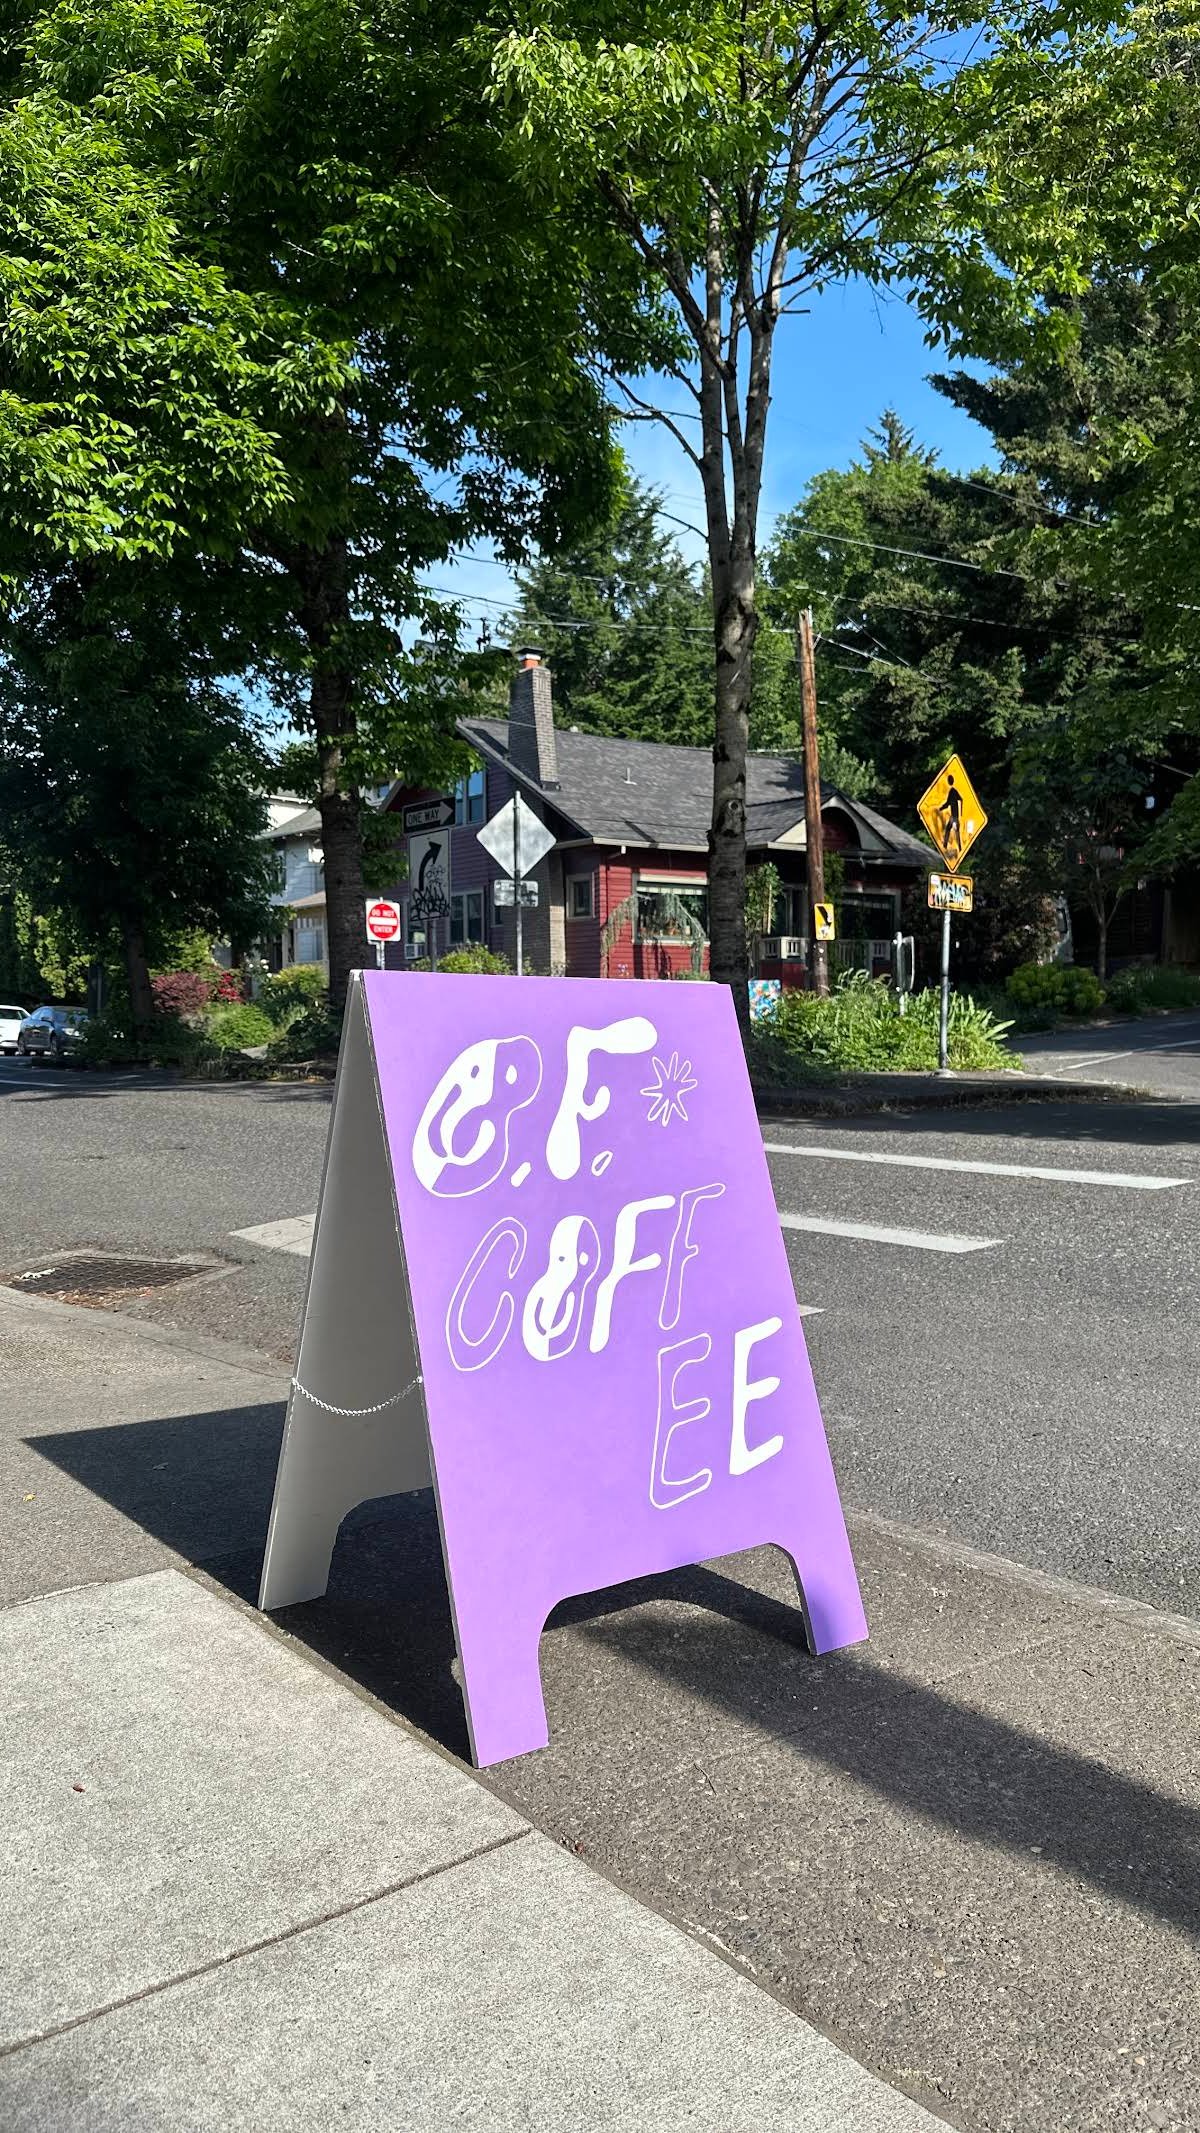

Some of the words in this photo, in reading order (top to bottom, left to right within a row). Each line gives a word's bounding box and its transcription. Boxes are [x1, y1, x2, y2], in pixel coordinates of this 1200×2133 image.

[408, 812, 423, 825] ONE
[424, 808, 440, 821] WAY
[371, 909, 381, 917] DO
[382, 909, 395, 918] NOT
[373, 925, 393, 934] ENTER
[445, 1182, 726, 1372] COFF
[650, 1316, 784, 1510] EE
